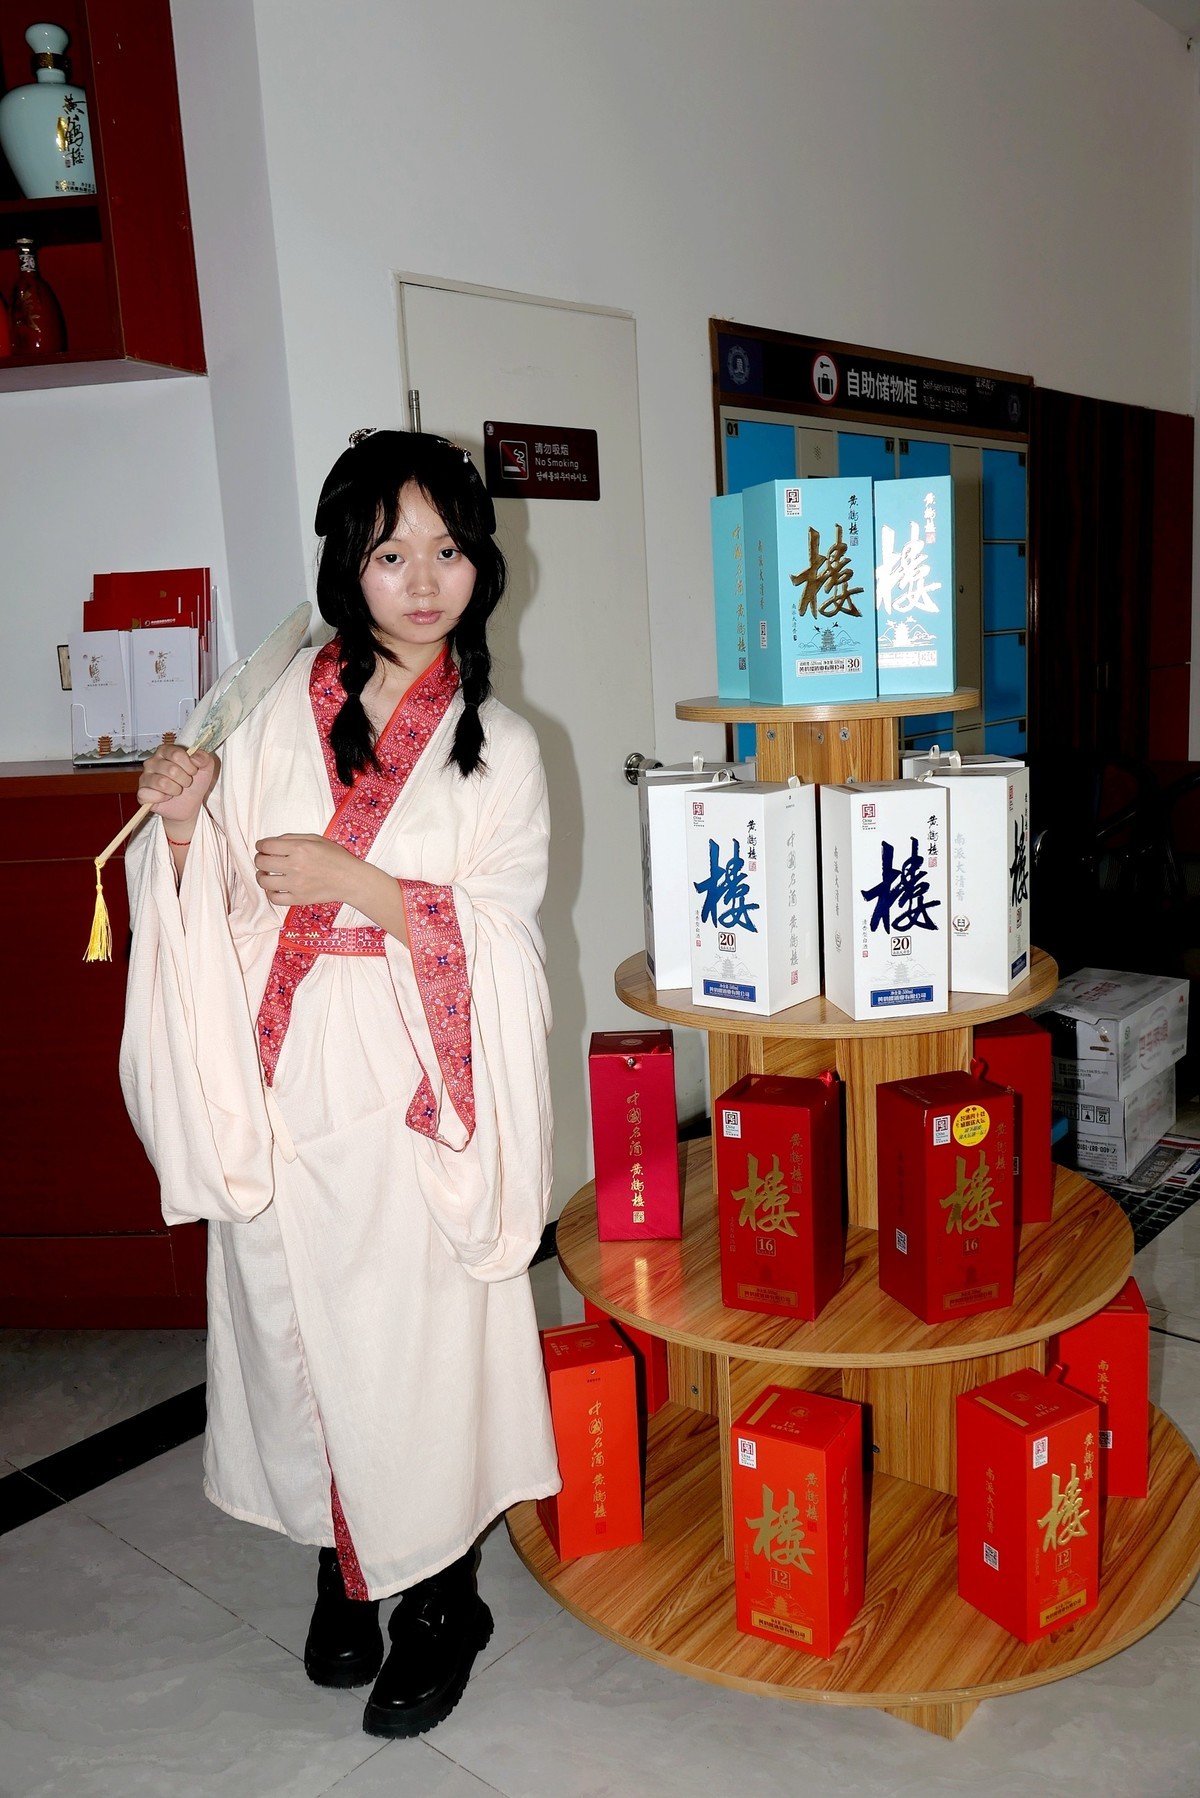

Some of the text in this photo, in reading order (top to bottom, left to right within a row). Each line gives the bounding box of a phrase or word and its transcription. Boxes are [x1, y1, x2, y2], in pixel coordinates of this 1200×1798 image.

[846, 368, 918, 405] 自助储物柜
[726, 422, 738, 436] 01
[534, 442, 568, 456] 请勿吸烟
[535, 458, 578, 470] No Smoking
[848, 658, 860, 668] 30
[720, 933, 734, 946] 20
[892, 938, 909, 952] 20
[758, 1238, 774, 1252] 16
[964, 1239, 978, 1251] 16
[1058, 1552, 1070, 1569] 12
[773, 1570, 788, 1584] 12
